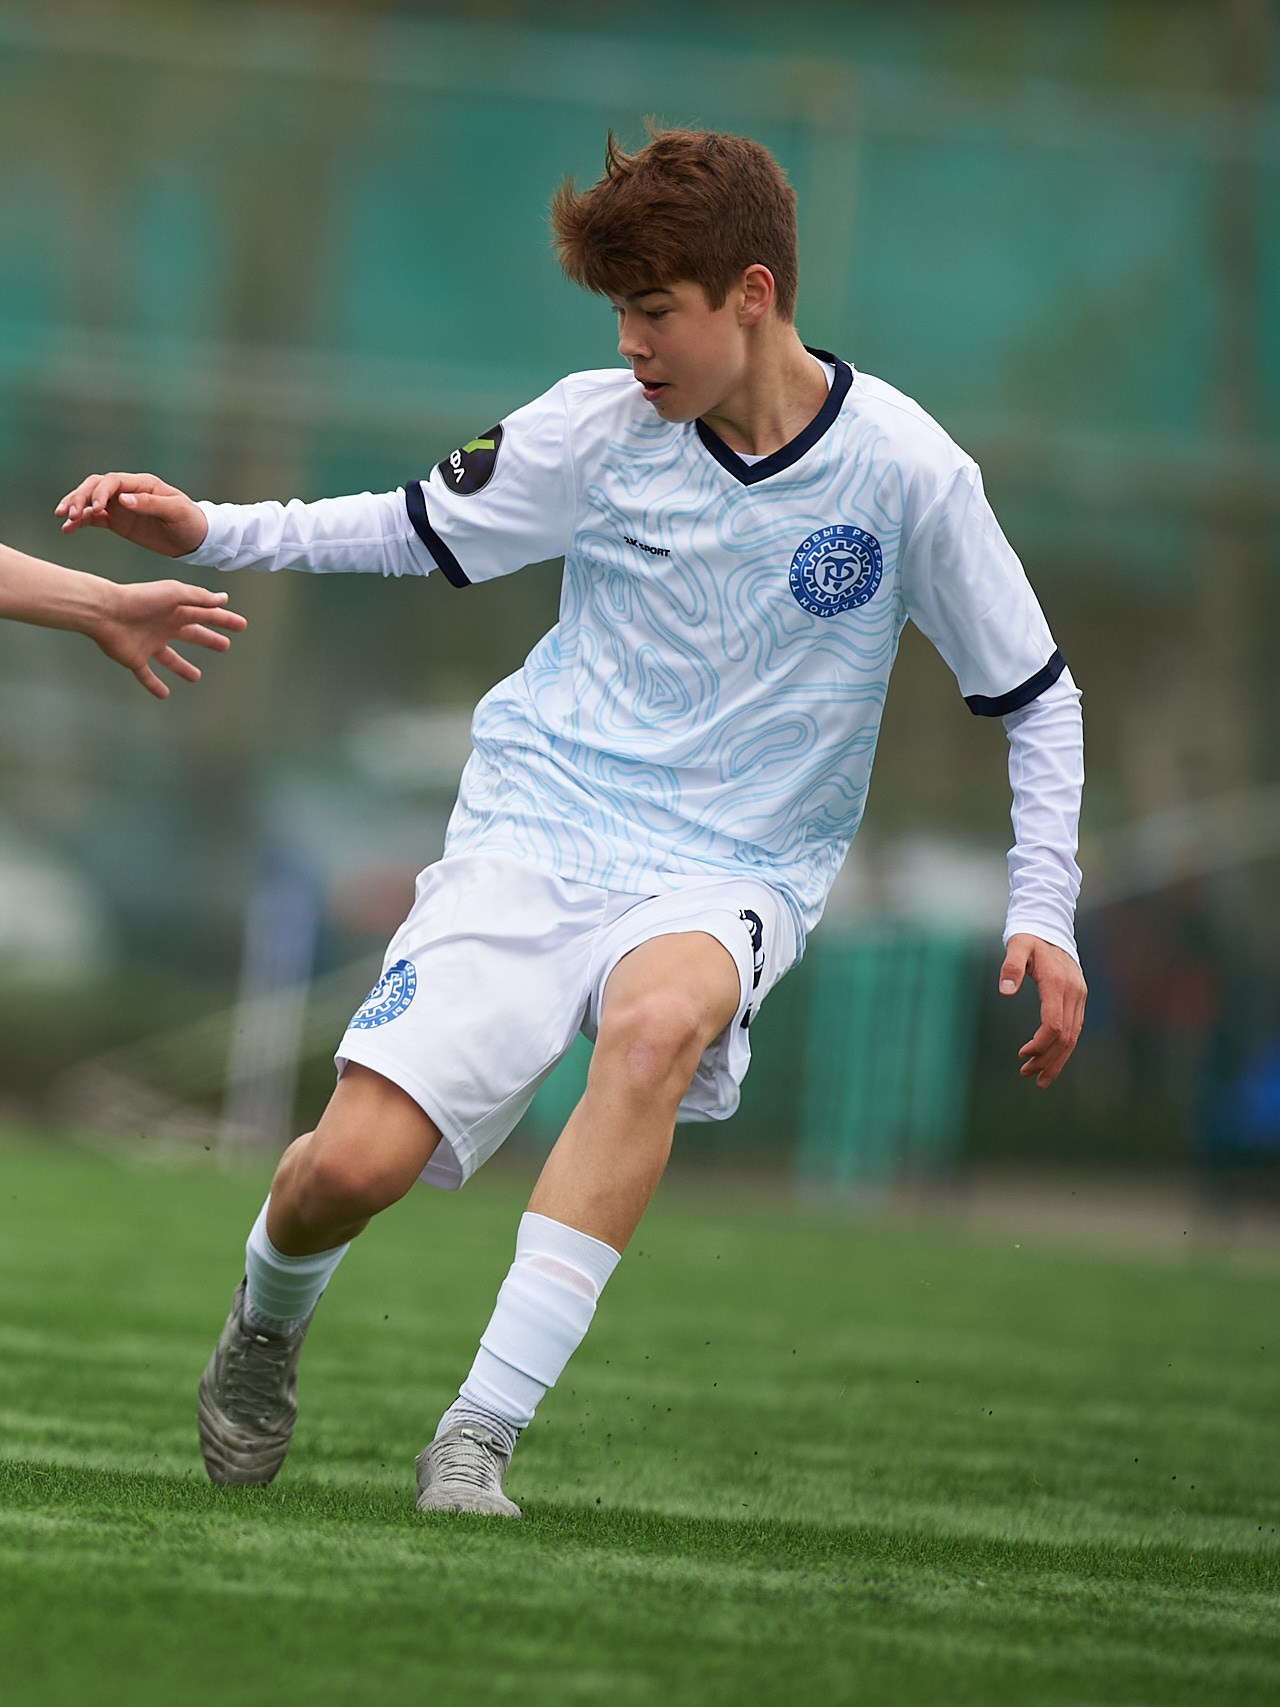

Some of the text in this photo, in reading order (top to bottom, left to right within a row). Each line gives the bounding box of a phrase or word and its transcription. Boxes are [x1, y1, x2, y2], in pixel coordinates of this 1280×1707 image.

[449, 449, 465, 484] ФЛ
[790, 526, 881, 616] ТРУДОВЫЕ РЕЗЕРВЫ СТАДИОН
